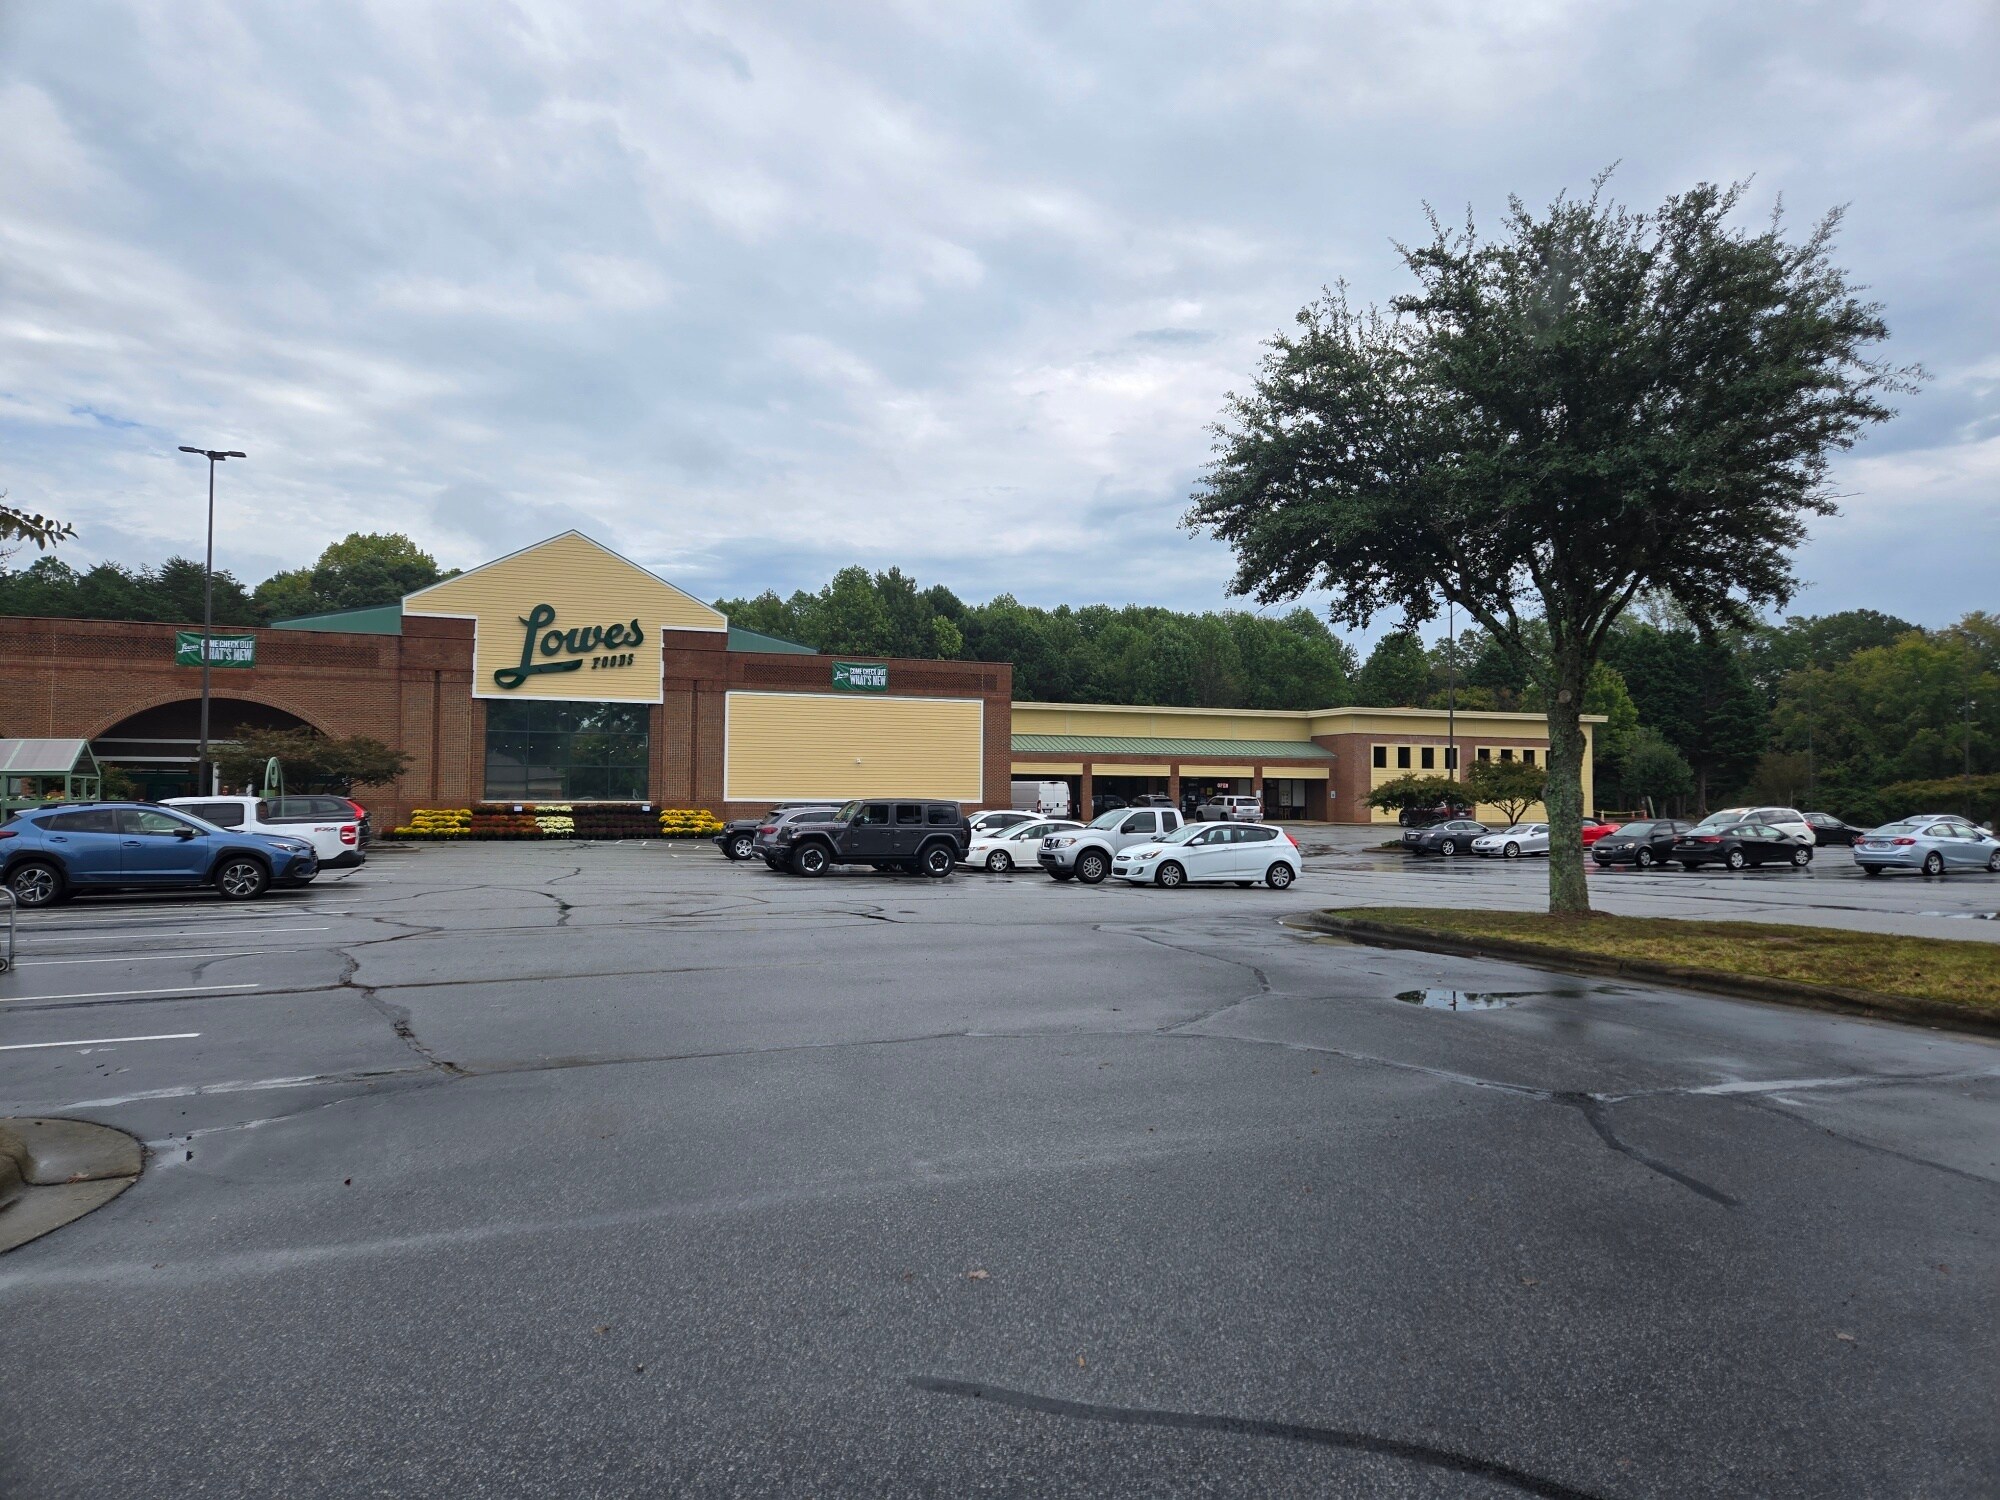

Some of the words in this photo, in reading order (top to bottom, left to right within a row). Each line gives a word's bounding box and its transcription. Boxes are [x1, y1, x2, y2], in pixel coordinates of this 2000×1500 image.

[201, 639, 218, 648] CME
[220, 640, 239, 648] CHECK
[240, 641, 252, 649] OUT
[494, 603, 644, 689] Lowes
[233, 649, 253, 660] NEW
[592, 653, 634, 669] FOODS
[850, 675, 872, 685] WHAT'S
[872, 676, 886, 686] NEW
